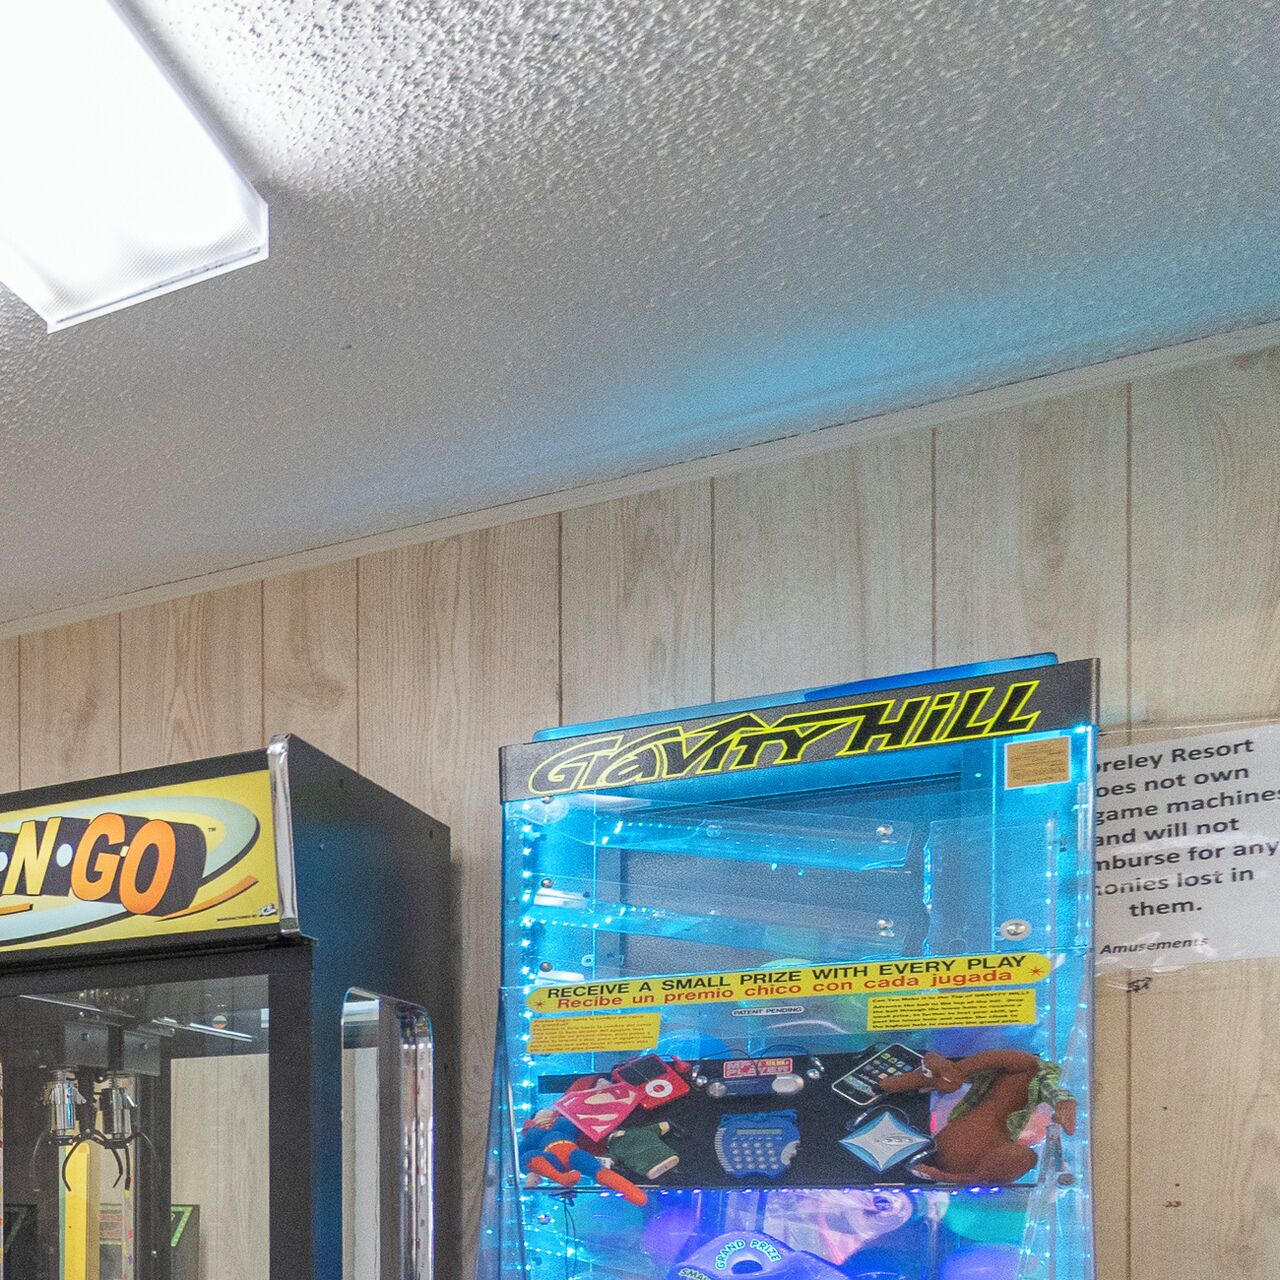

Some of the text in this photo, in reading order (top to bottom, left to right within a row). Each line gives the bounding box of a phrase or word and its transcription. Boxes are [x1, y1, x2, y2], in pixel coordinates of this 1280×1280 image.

[1171, 739, 1254, 764] Resort
[1144, 774, 1186, 792] not
[1194, 767, 1249, 785] own
[1096, 789, 1280, 825] game machines
[1095, 818, 1240, 846] and will not
[1189, 846, 1225, 861] for
[1233, 841, 1280, 857] any
[1177, 871, 1223, 888] lost
[1232, 867, 1254, 882] in
[1129, 901, 1202, 917] them.
[1100, 936, 1209, 954] Amusements
[547, 955, 1026, 999] RECEIVE A SMALL PRIZE WITH EVERY PLAY
[557, 969, 1012, 1009] Recibe un premio chico con cada jugada
[766, 1006, 802, 1015] PENDING
[715, 1239, 781, 1270] GRAND PRIZE
